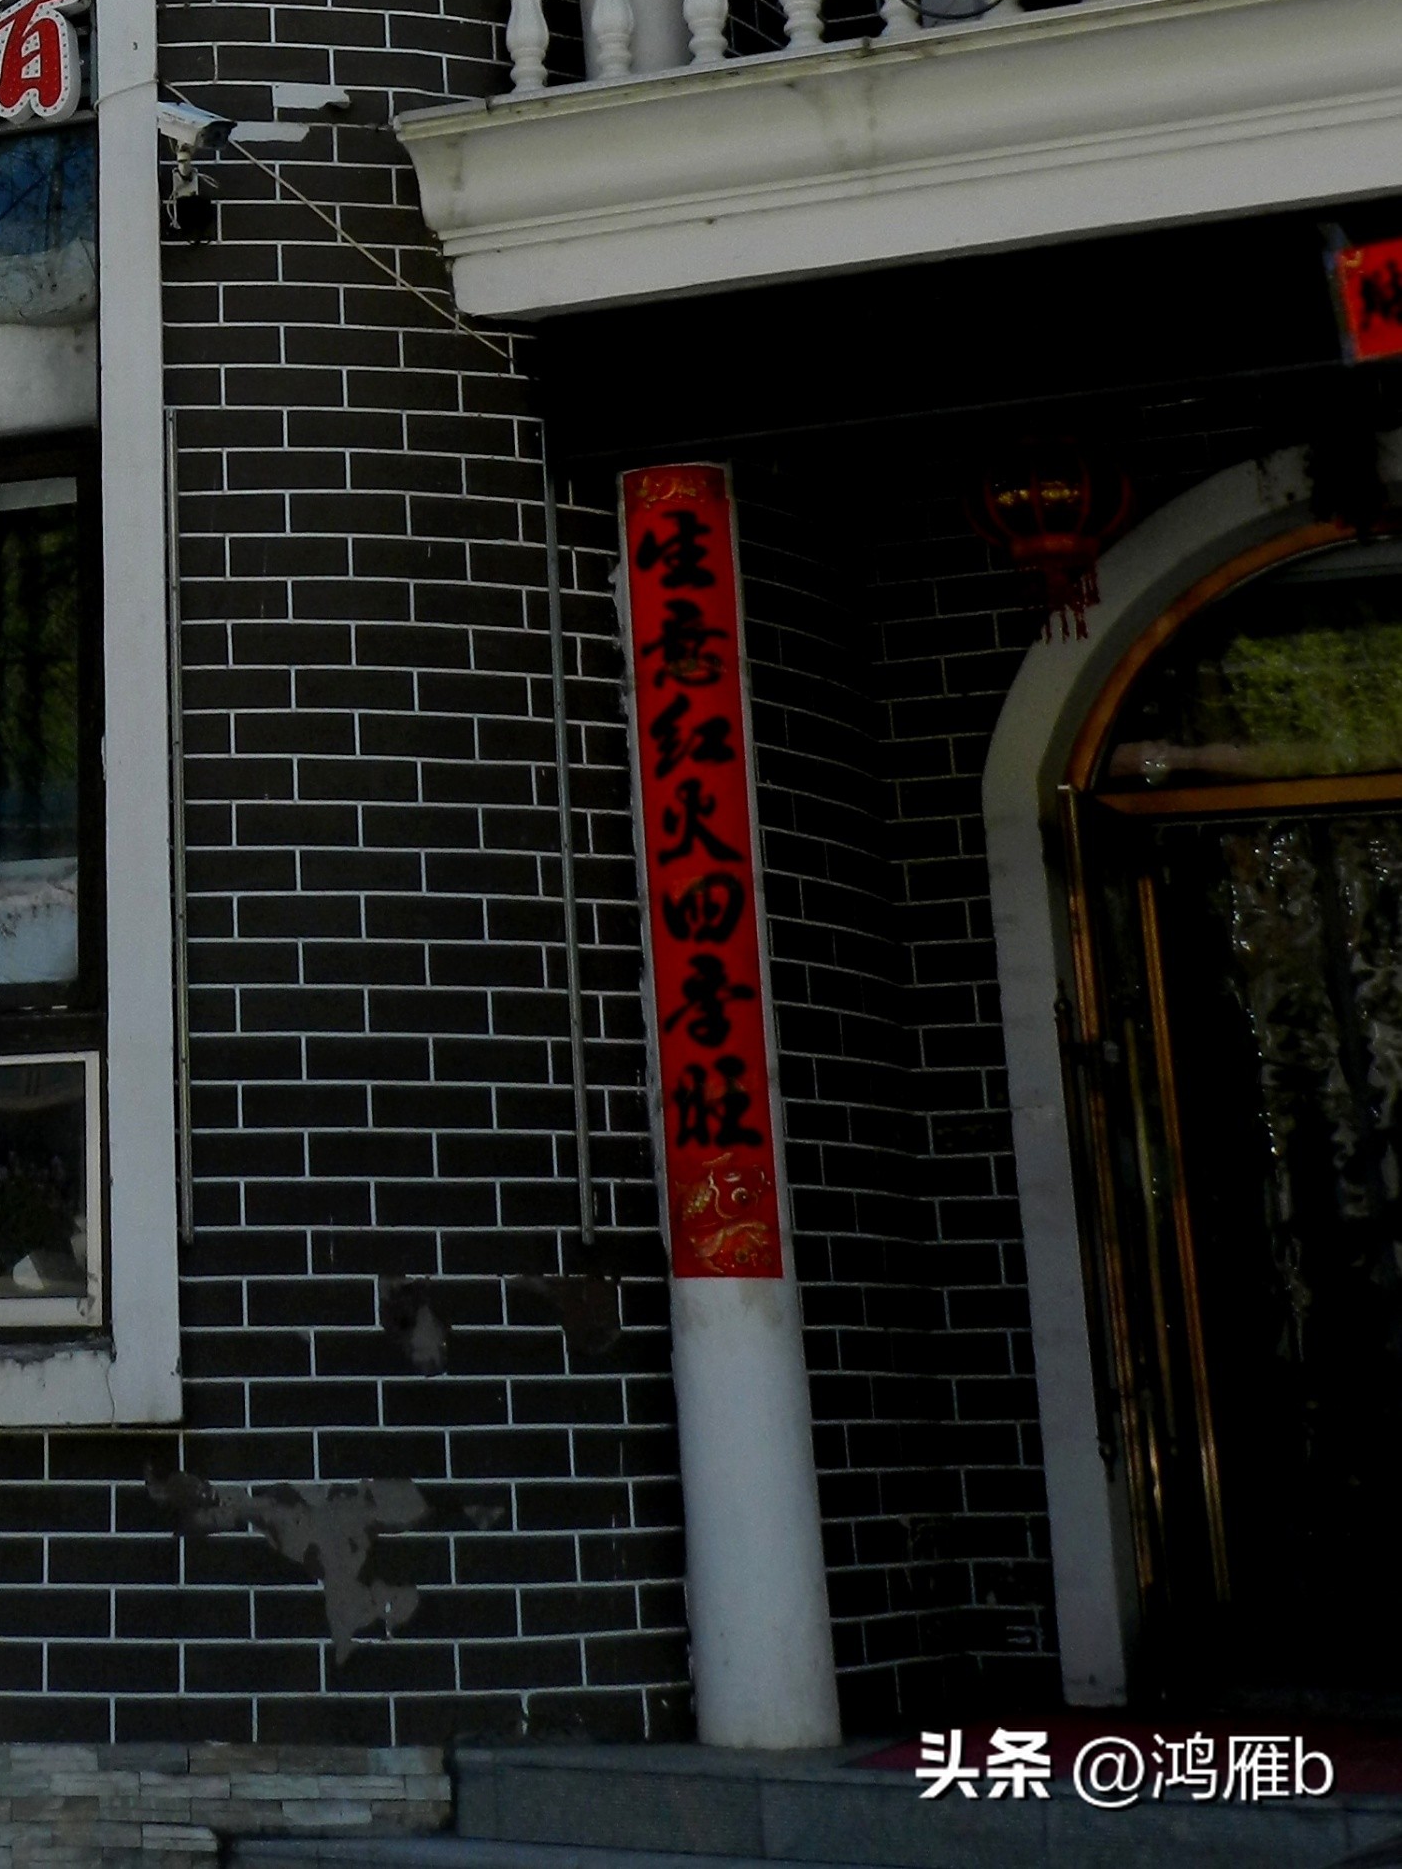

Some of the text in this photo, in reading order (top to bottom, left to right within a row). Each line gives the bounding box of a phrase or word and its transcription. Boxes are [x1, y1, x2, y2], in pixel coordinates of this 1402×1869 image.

[635, 509, 765, 1149] 生意红火四季旺
